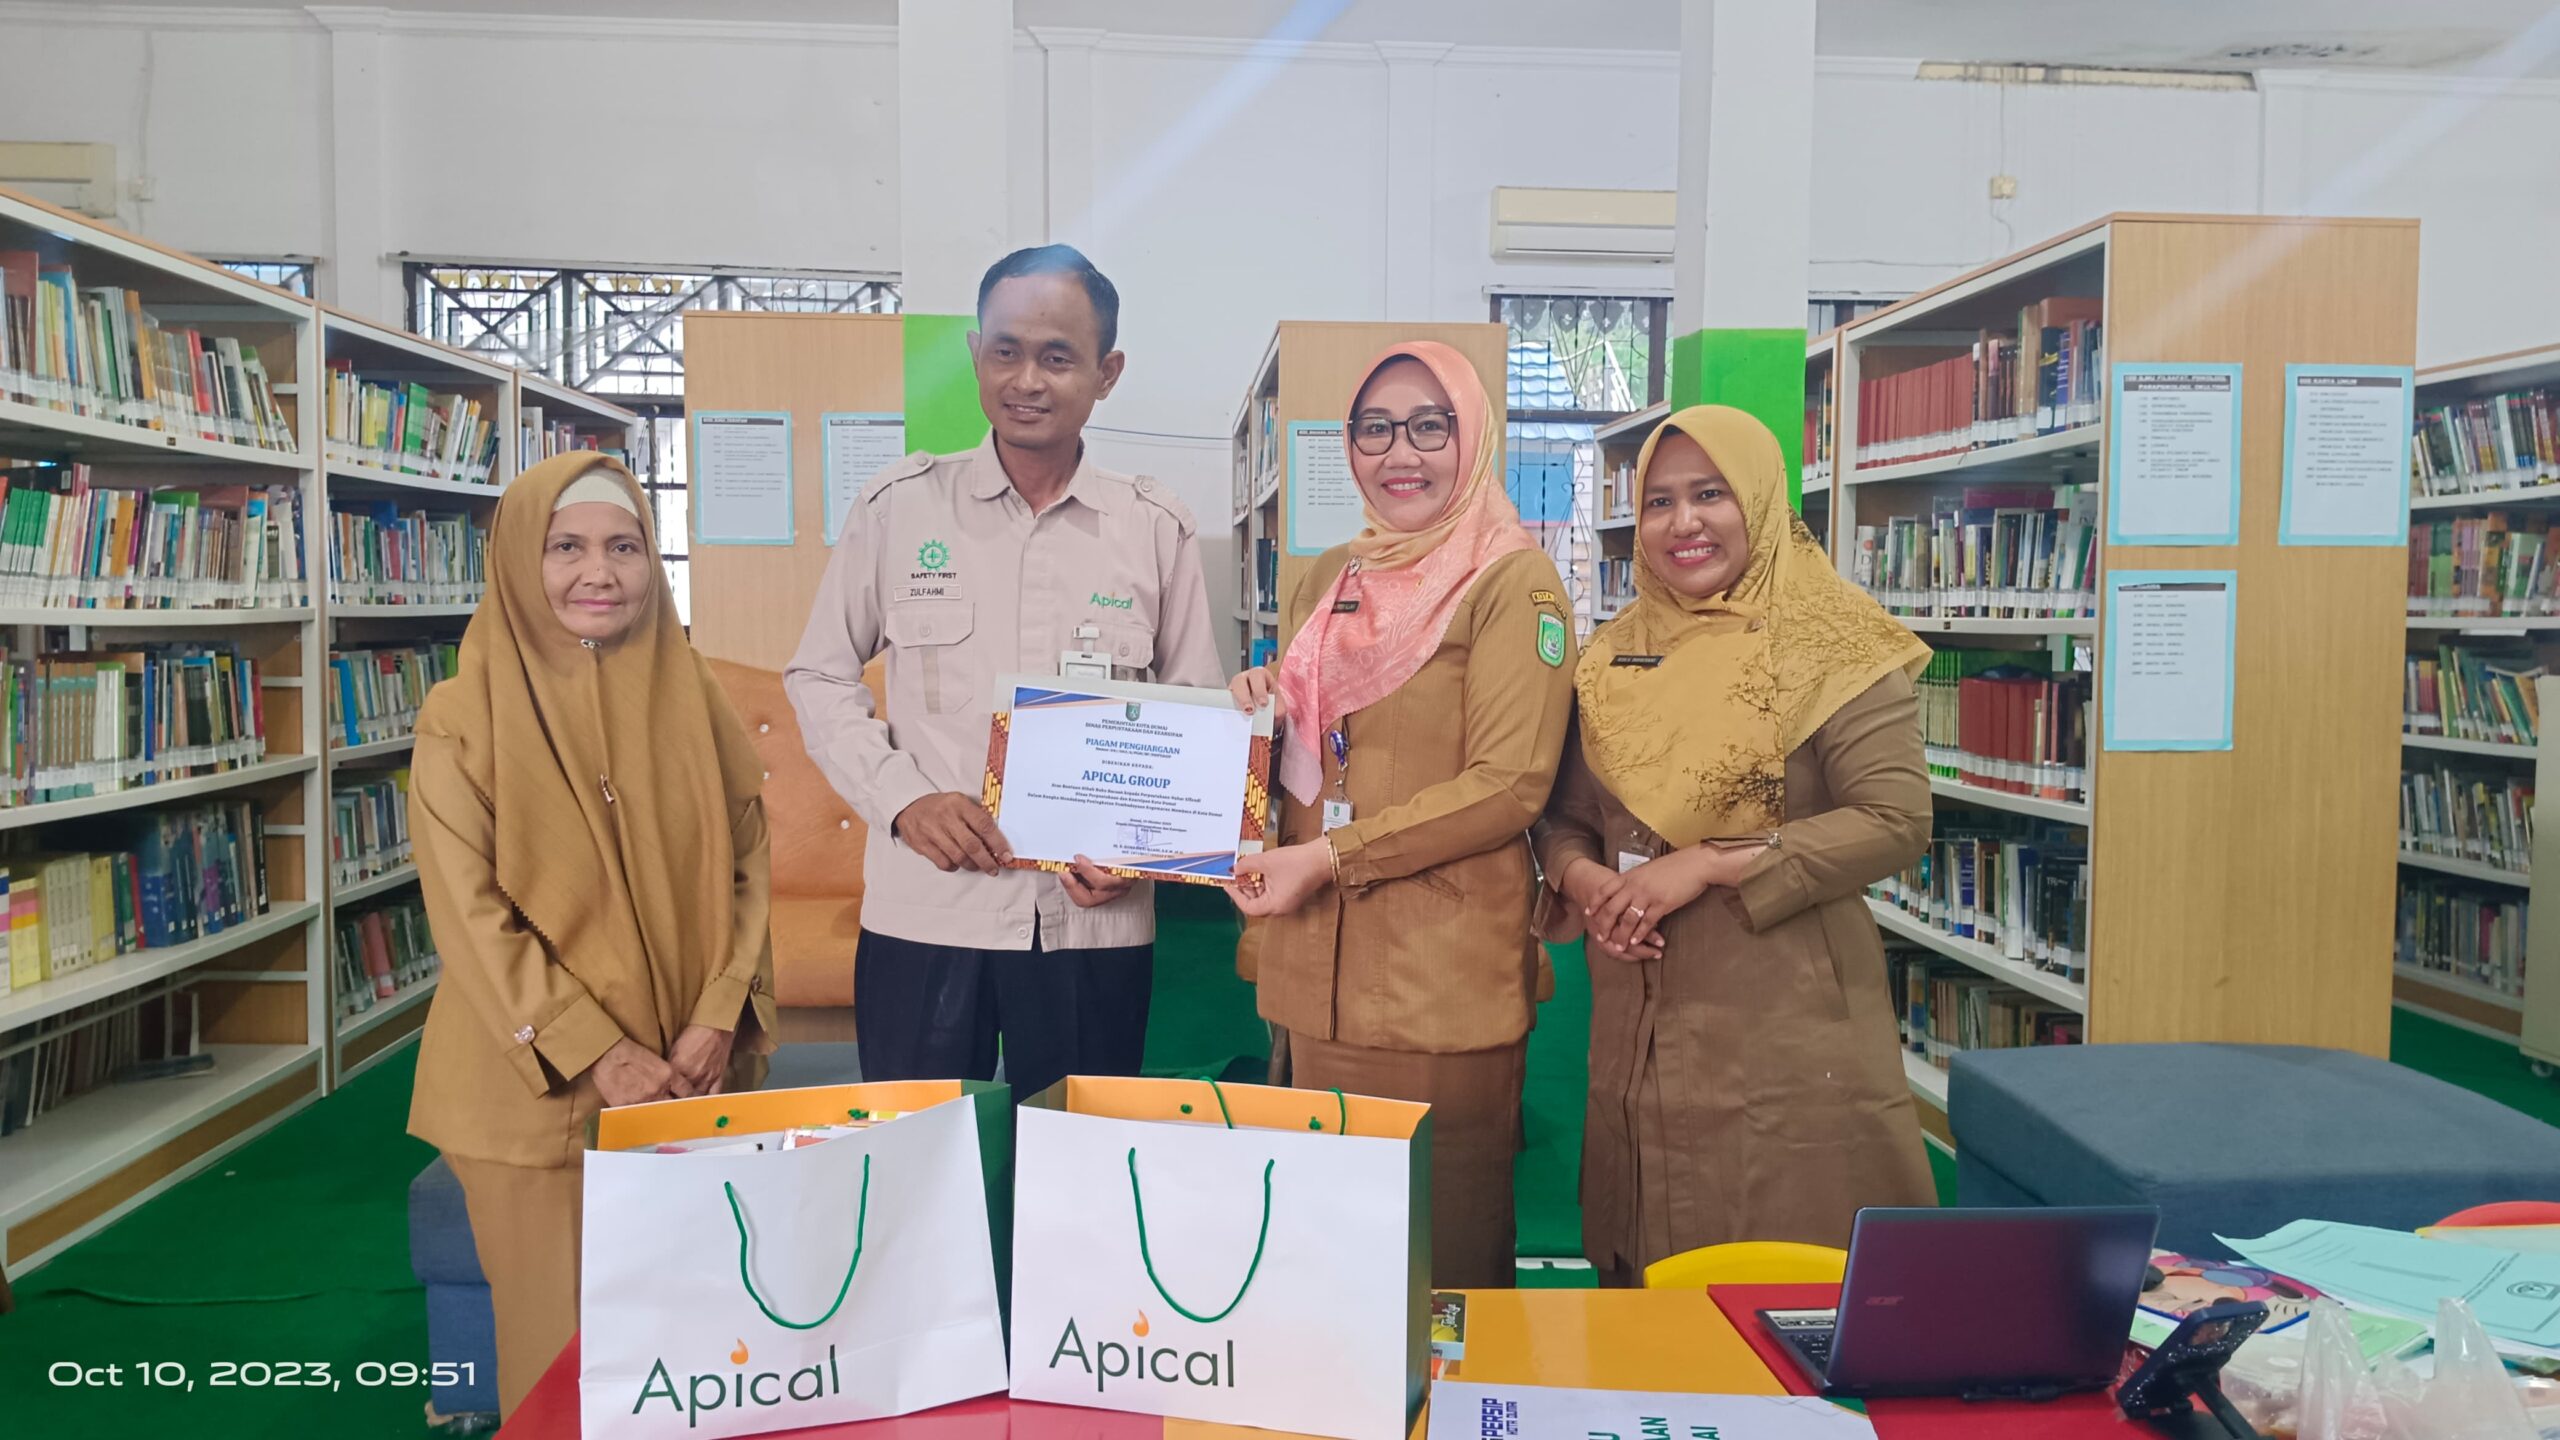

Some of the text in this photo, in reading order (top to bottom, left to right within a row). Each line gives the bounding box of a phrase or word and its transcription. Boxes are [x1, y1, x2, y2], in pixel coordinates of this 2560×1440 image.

[910, 588, 945, 597] ZULFAHMI
[1089, 592, 1133, 610] Apical
[1534, 592, 1551, 600] KOTA
[1085, 737, 1117, 747] PIAGAM
[1119, 741, 1180, 754] PENGHARGAAN
[1081, 770, 1171, 788] APICAL GROUP
[1049, 1311, 1235, 1392] Apical
[632, 1339, 840, 1428] Apical
